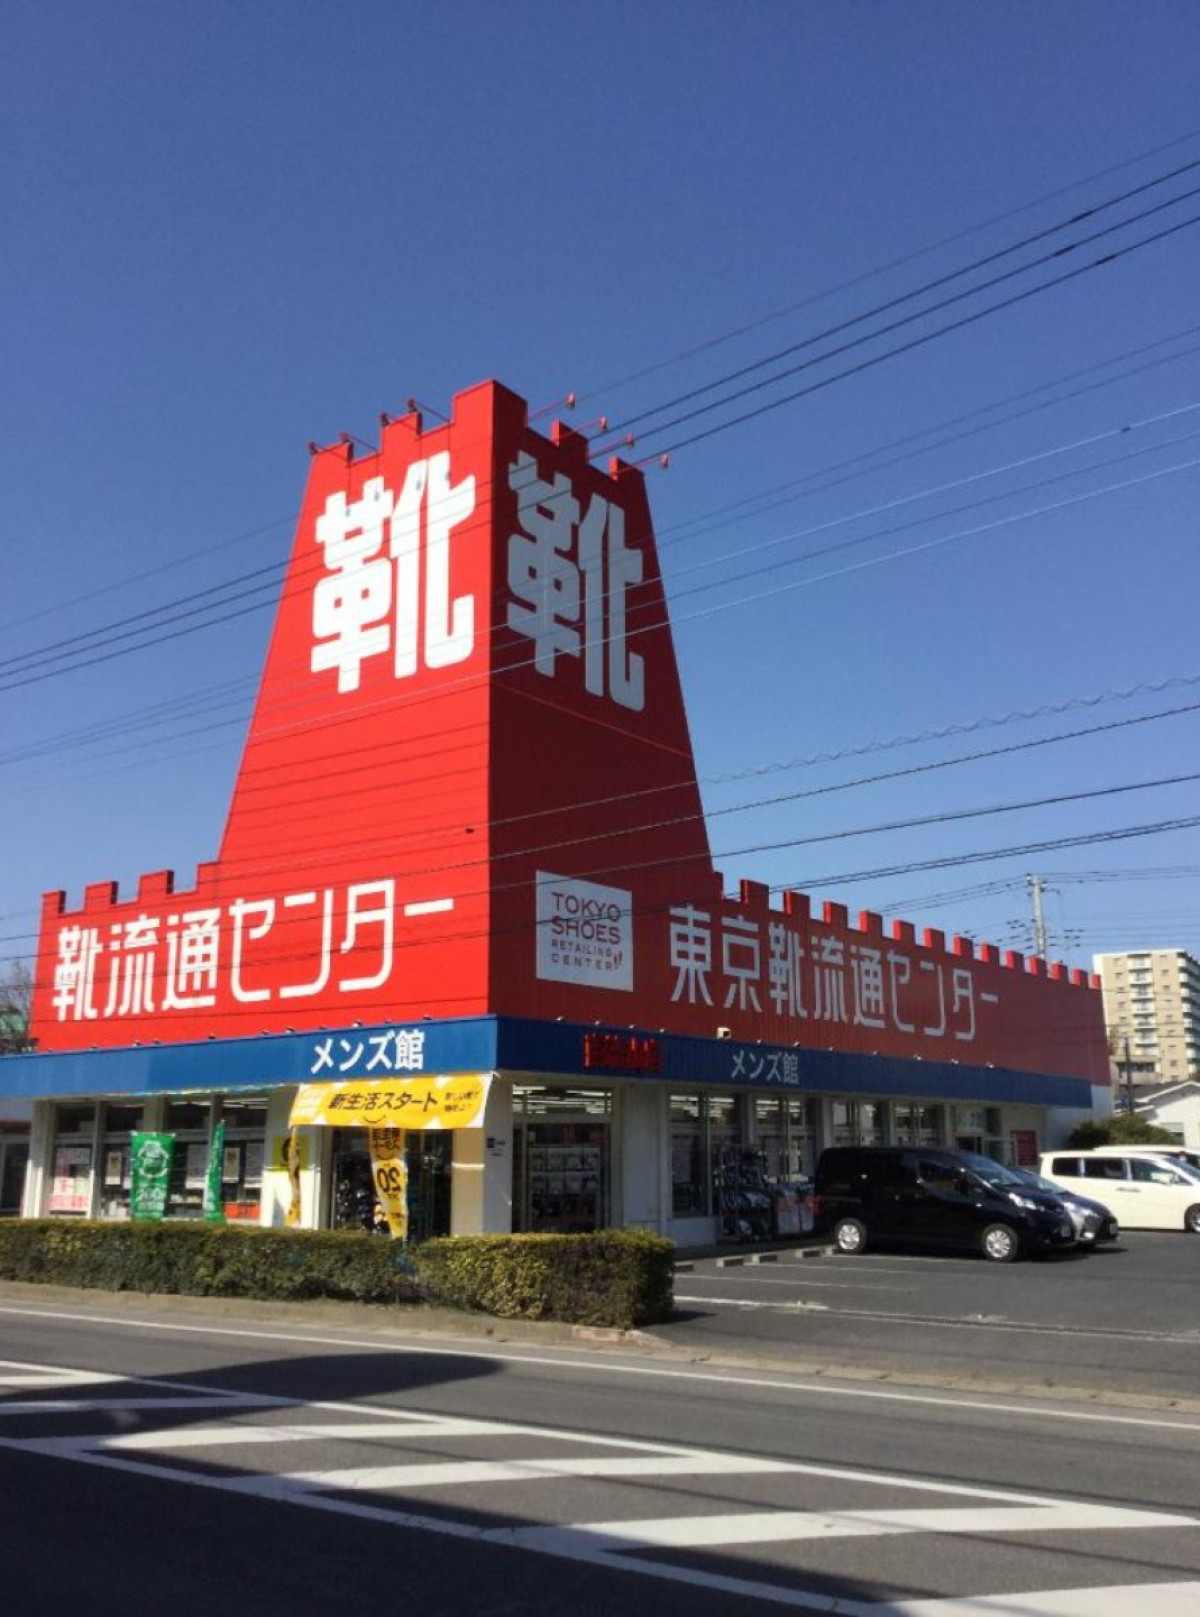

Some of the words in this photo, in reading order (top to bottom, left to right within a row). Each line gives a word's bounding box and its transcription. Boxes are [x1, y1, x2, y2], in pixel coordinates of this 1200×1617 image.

[311, 450, 475, 694] 靴
[507, 449, 645, 713] 靴
[552, 892, 622, 923] TOKYO
[552, 916, 621, 945] SHOES
[552, 938, 612, 957] RETAILING
[52, 877, 454, 1022] 靴流通センター
[552, 953, 613, 970] CENTER
[669, 903, 999, 1041] 東京靴流通センター
[310, 1030, 424, 1074] メンズ館
[730, 1049, 800, 1086] メンズ館
[327, 1090, 438, 1113] 新生活スタート
